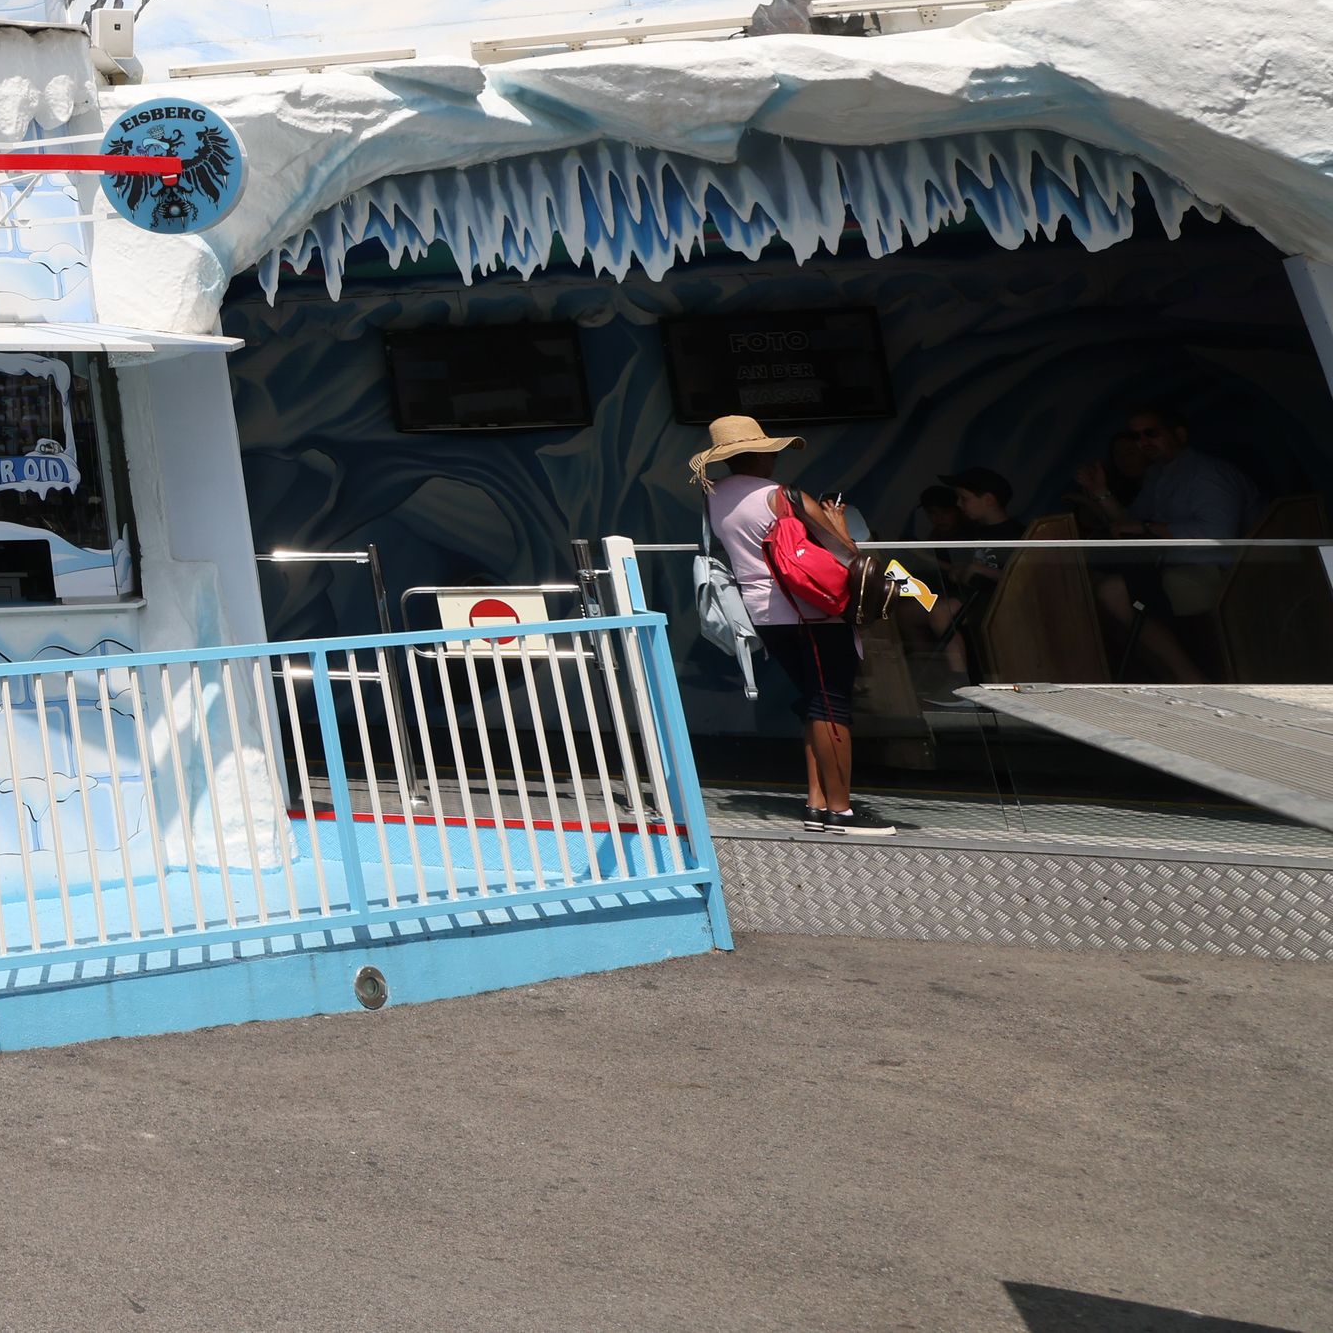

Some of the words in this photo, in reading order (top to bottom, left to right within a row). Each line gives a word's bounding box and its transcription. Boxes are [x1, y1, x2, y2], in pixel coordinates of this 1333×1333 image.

[119, 106, 207, 133] EISBERG
[728, 330, 809, 353] FOTO
[737, 364, 768, 380] AN
[773, 362, 815, 379] DER
[23, 457, 64, 483] OID
